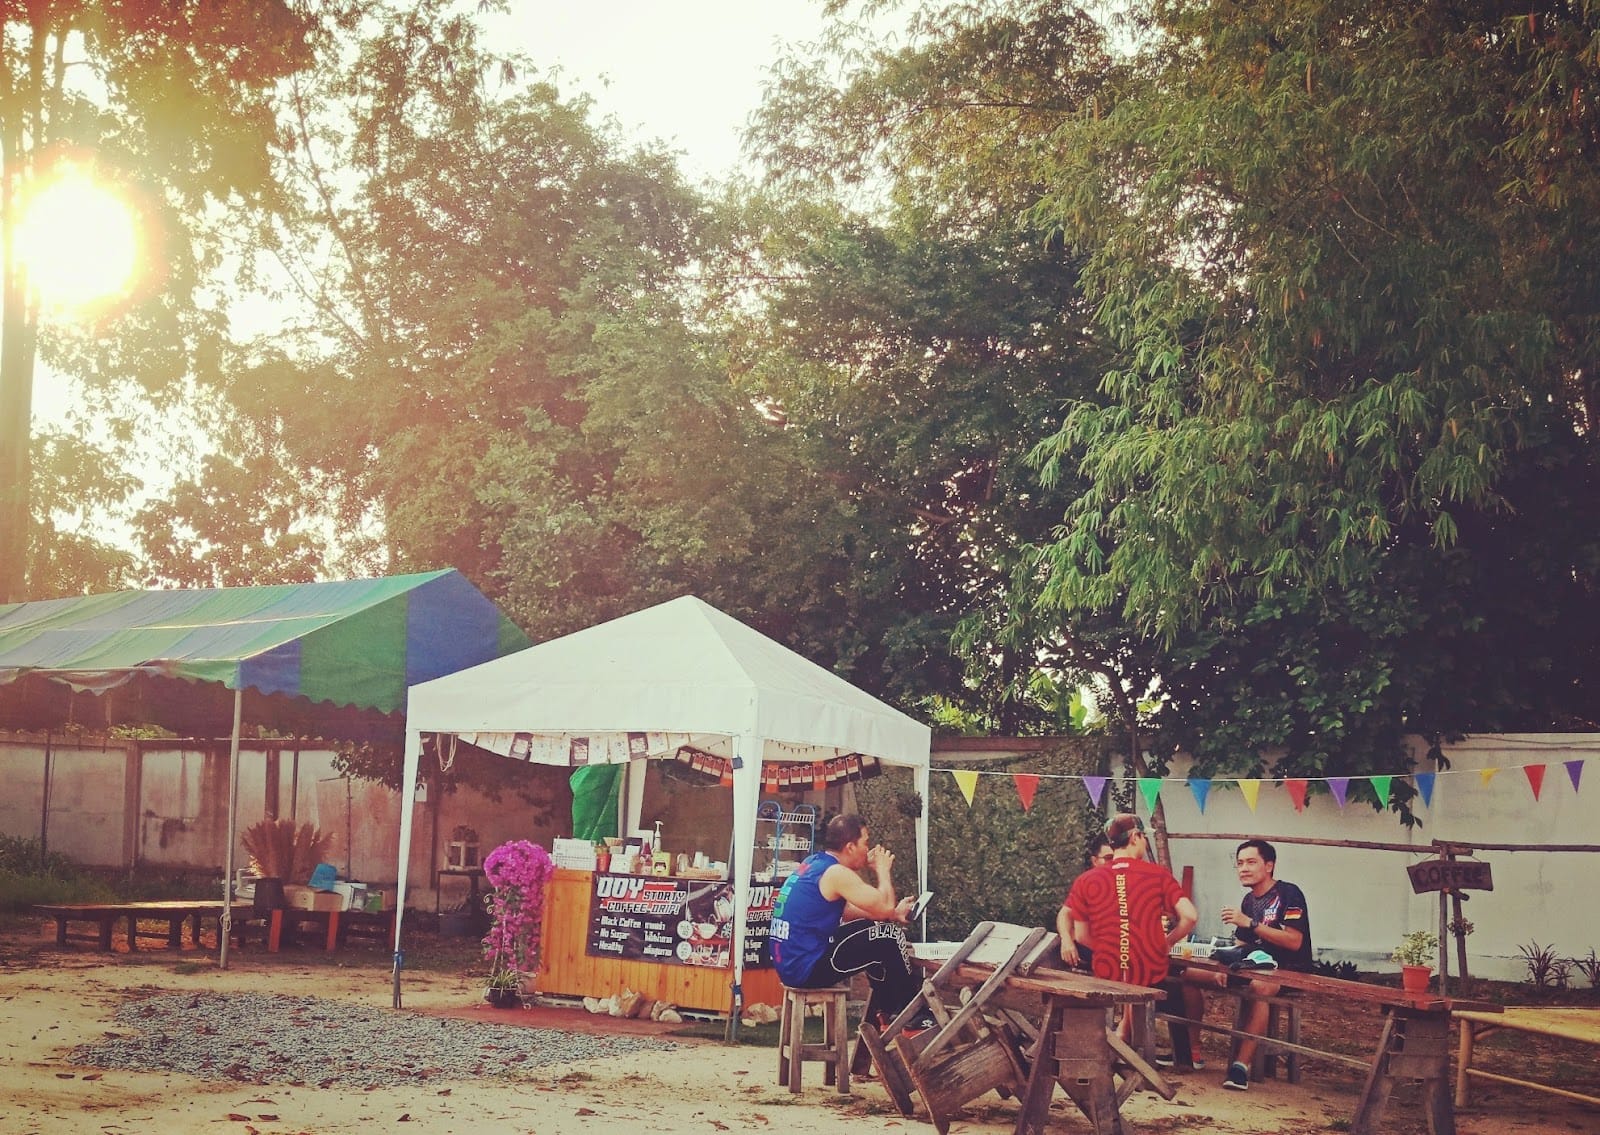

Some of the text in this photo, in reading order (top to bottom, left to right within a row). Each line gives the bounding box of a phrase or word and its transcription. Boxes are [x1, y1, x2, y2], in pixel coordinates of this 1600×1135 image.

[1415, 866, 1487, 887] COFFEE
[601, 915, 642, 928] Black Coffee
[1115, 873, 1129, 969] PORDYAI RUNNER
[599, 928, 630, 941] No Sugar
[599, 940, 624, 953] Healthy
